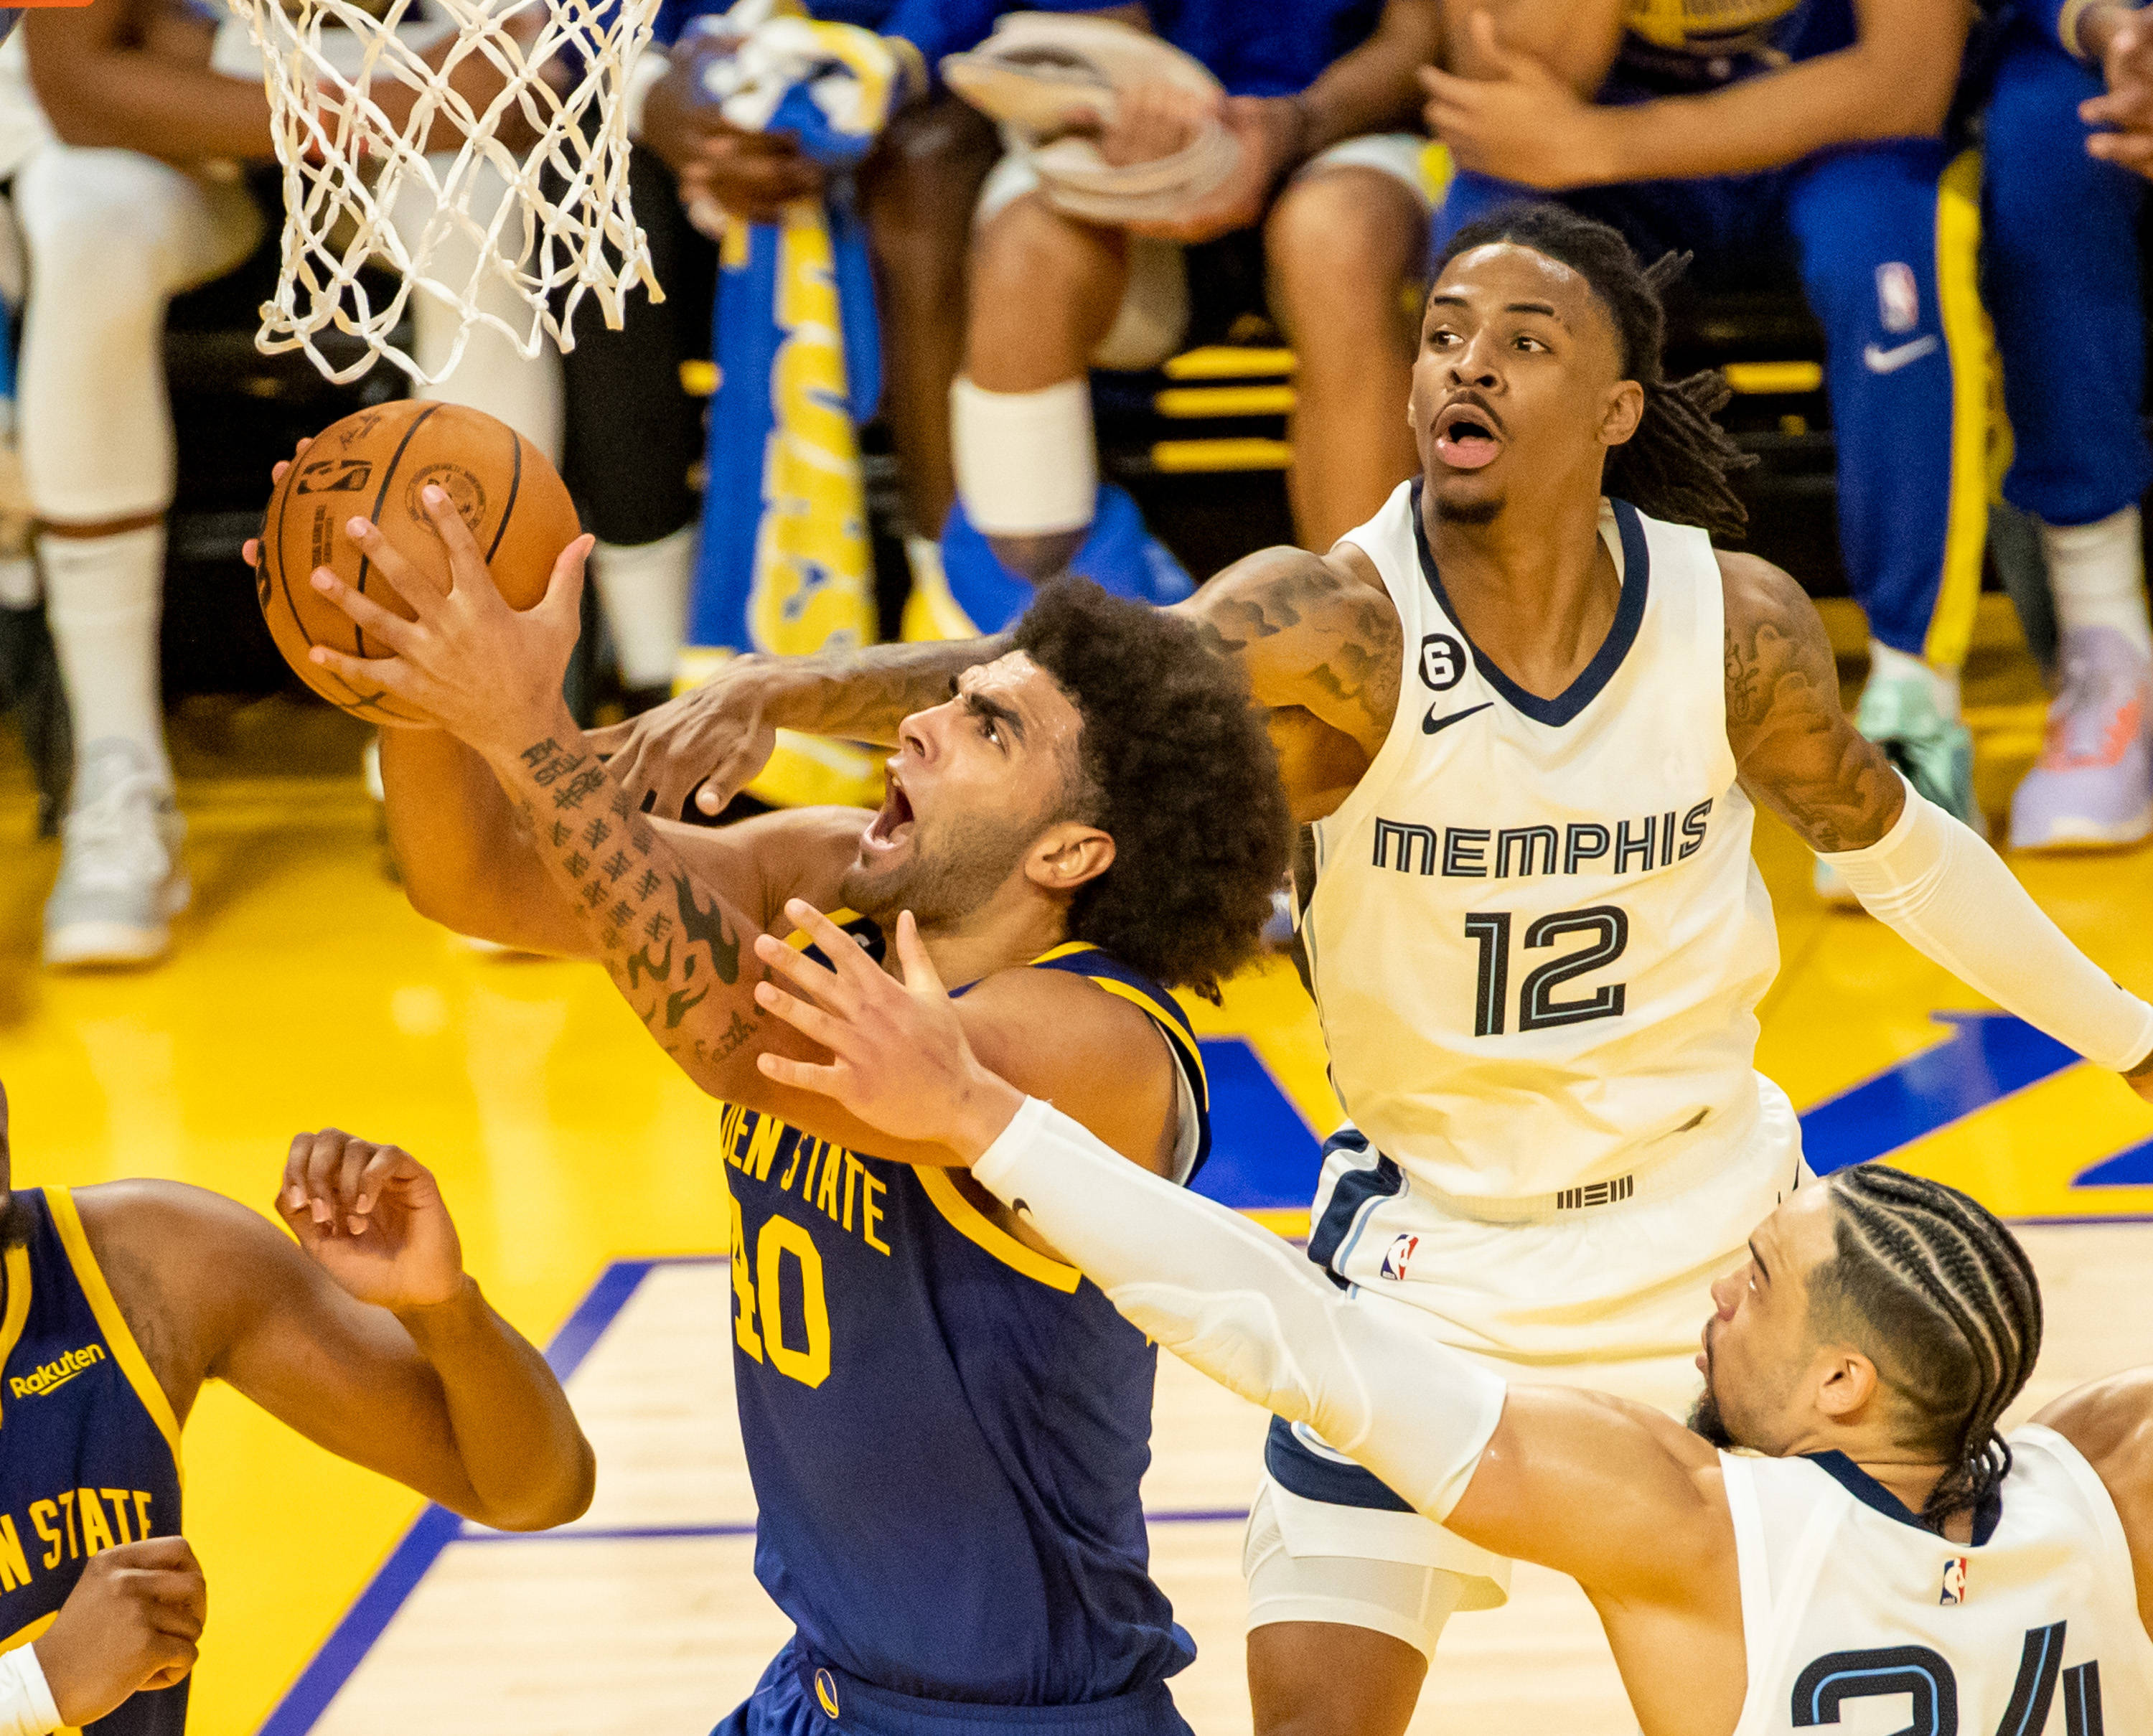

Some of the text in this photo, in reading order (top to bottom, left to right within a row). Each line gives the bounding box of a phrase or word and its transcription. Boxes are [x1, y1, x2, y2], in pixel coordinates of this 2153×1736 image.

[1423, 641, 1454, 685] 6
[1372, 797, 1713, 878] MEMPHIS
[1465, 905, 1628, 1037] 12
[780, 1130, 891, 1257] STATE
[730, 1194, 832, 1389] 40
[9, 1341, 105, 1399] Rakuten
[28, 1487, 152, 1570] STATE
